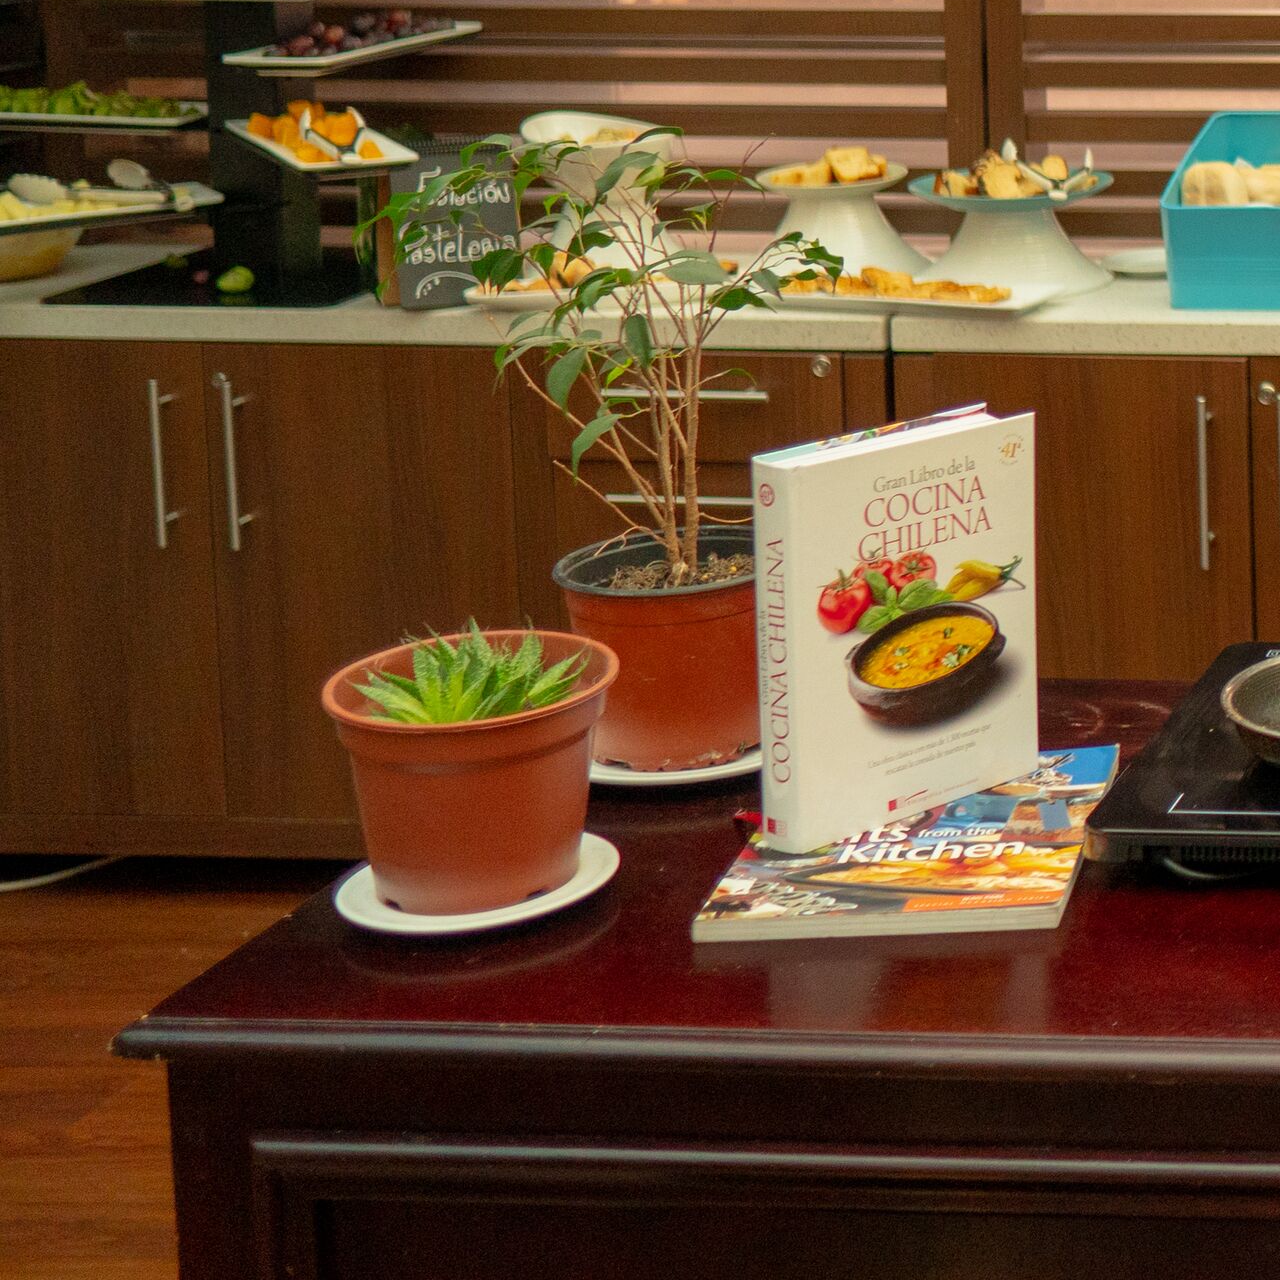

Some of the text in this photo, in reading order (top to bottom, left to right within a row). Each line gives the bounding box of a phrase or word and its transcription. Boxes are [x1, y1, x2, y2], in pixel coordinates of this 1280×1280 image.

[873, 455, 976, 493] Gran Libro de la
[863, 475, 987, 528] COCINA
[858, 506, 993, 563] CHILENA
[765, 538, 791, 785] COCINA CHILENA
[837, 840, 1026, 865] Kitchen
[918, 828, 960, 839] from
[965, 826, 999, 837] the
